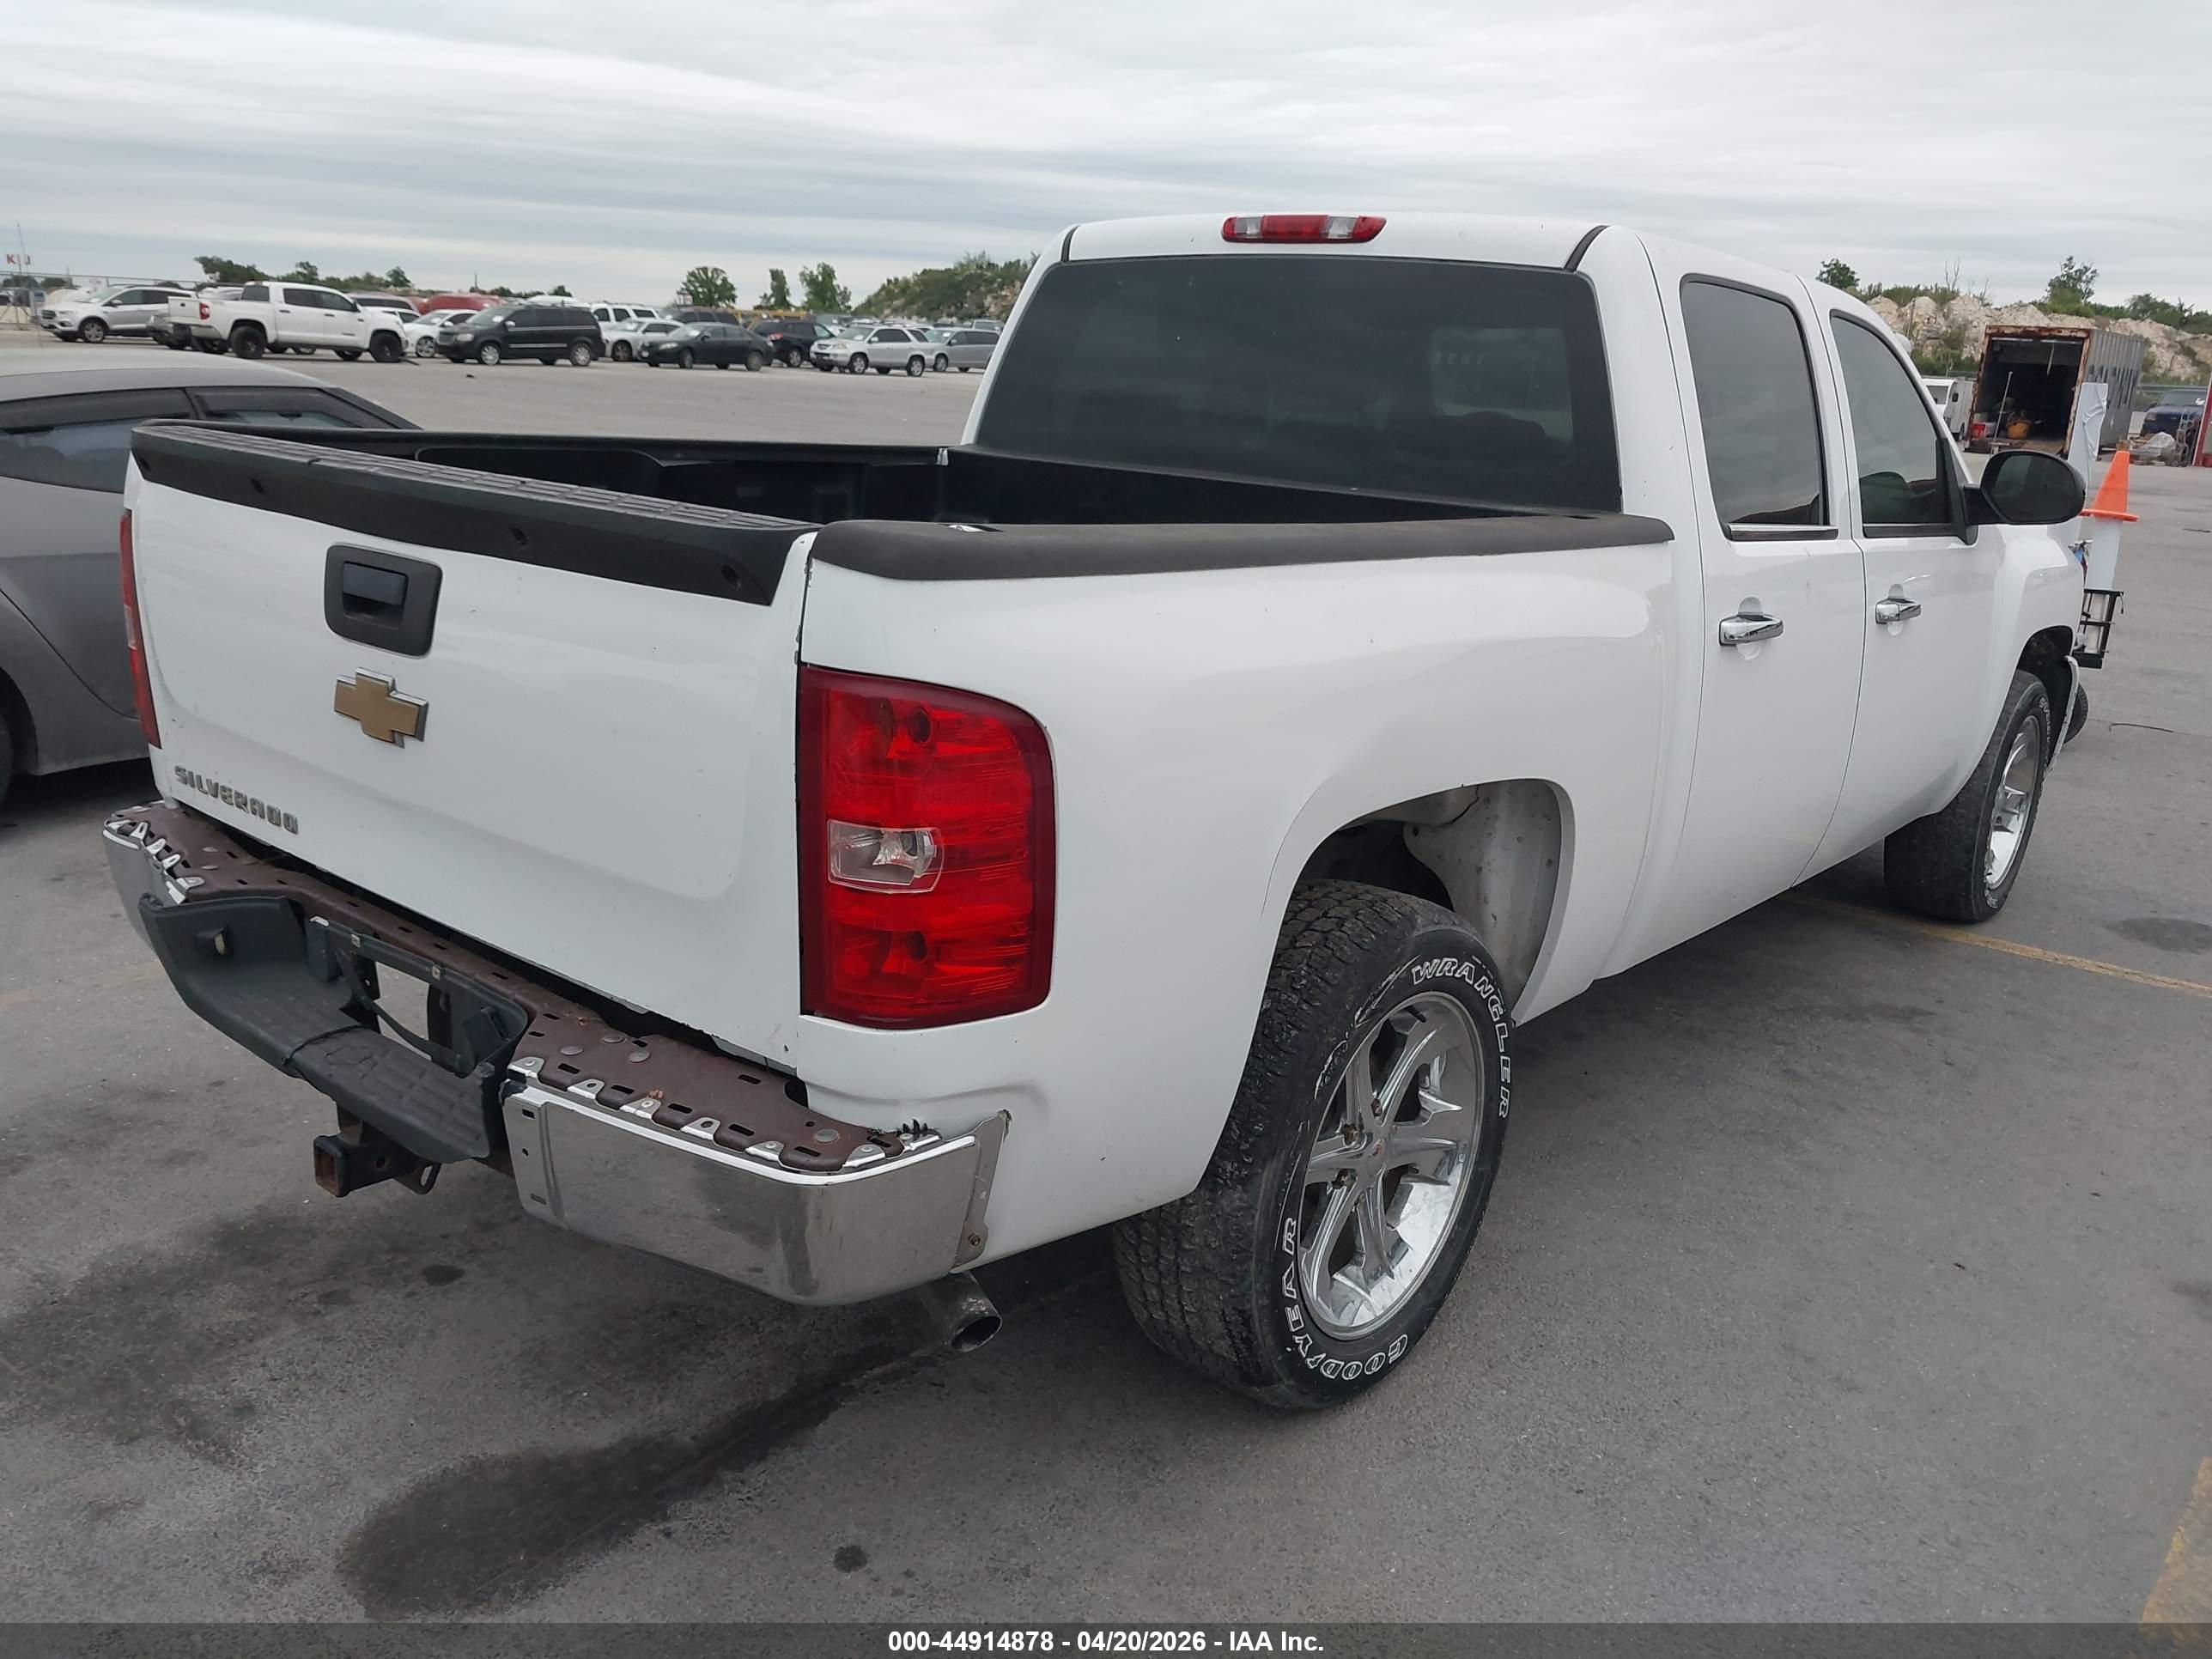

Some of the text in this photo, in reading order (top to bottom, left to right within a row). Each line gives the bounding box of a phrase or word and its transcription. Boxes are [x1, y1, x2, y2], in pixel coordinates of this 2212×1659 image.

[174, 765, 299, 835] SILVERADO
[1411, 957, 1511, 1118] WRANGLER
[1282, 1217, 1408, 1380] GOODYEAR
